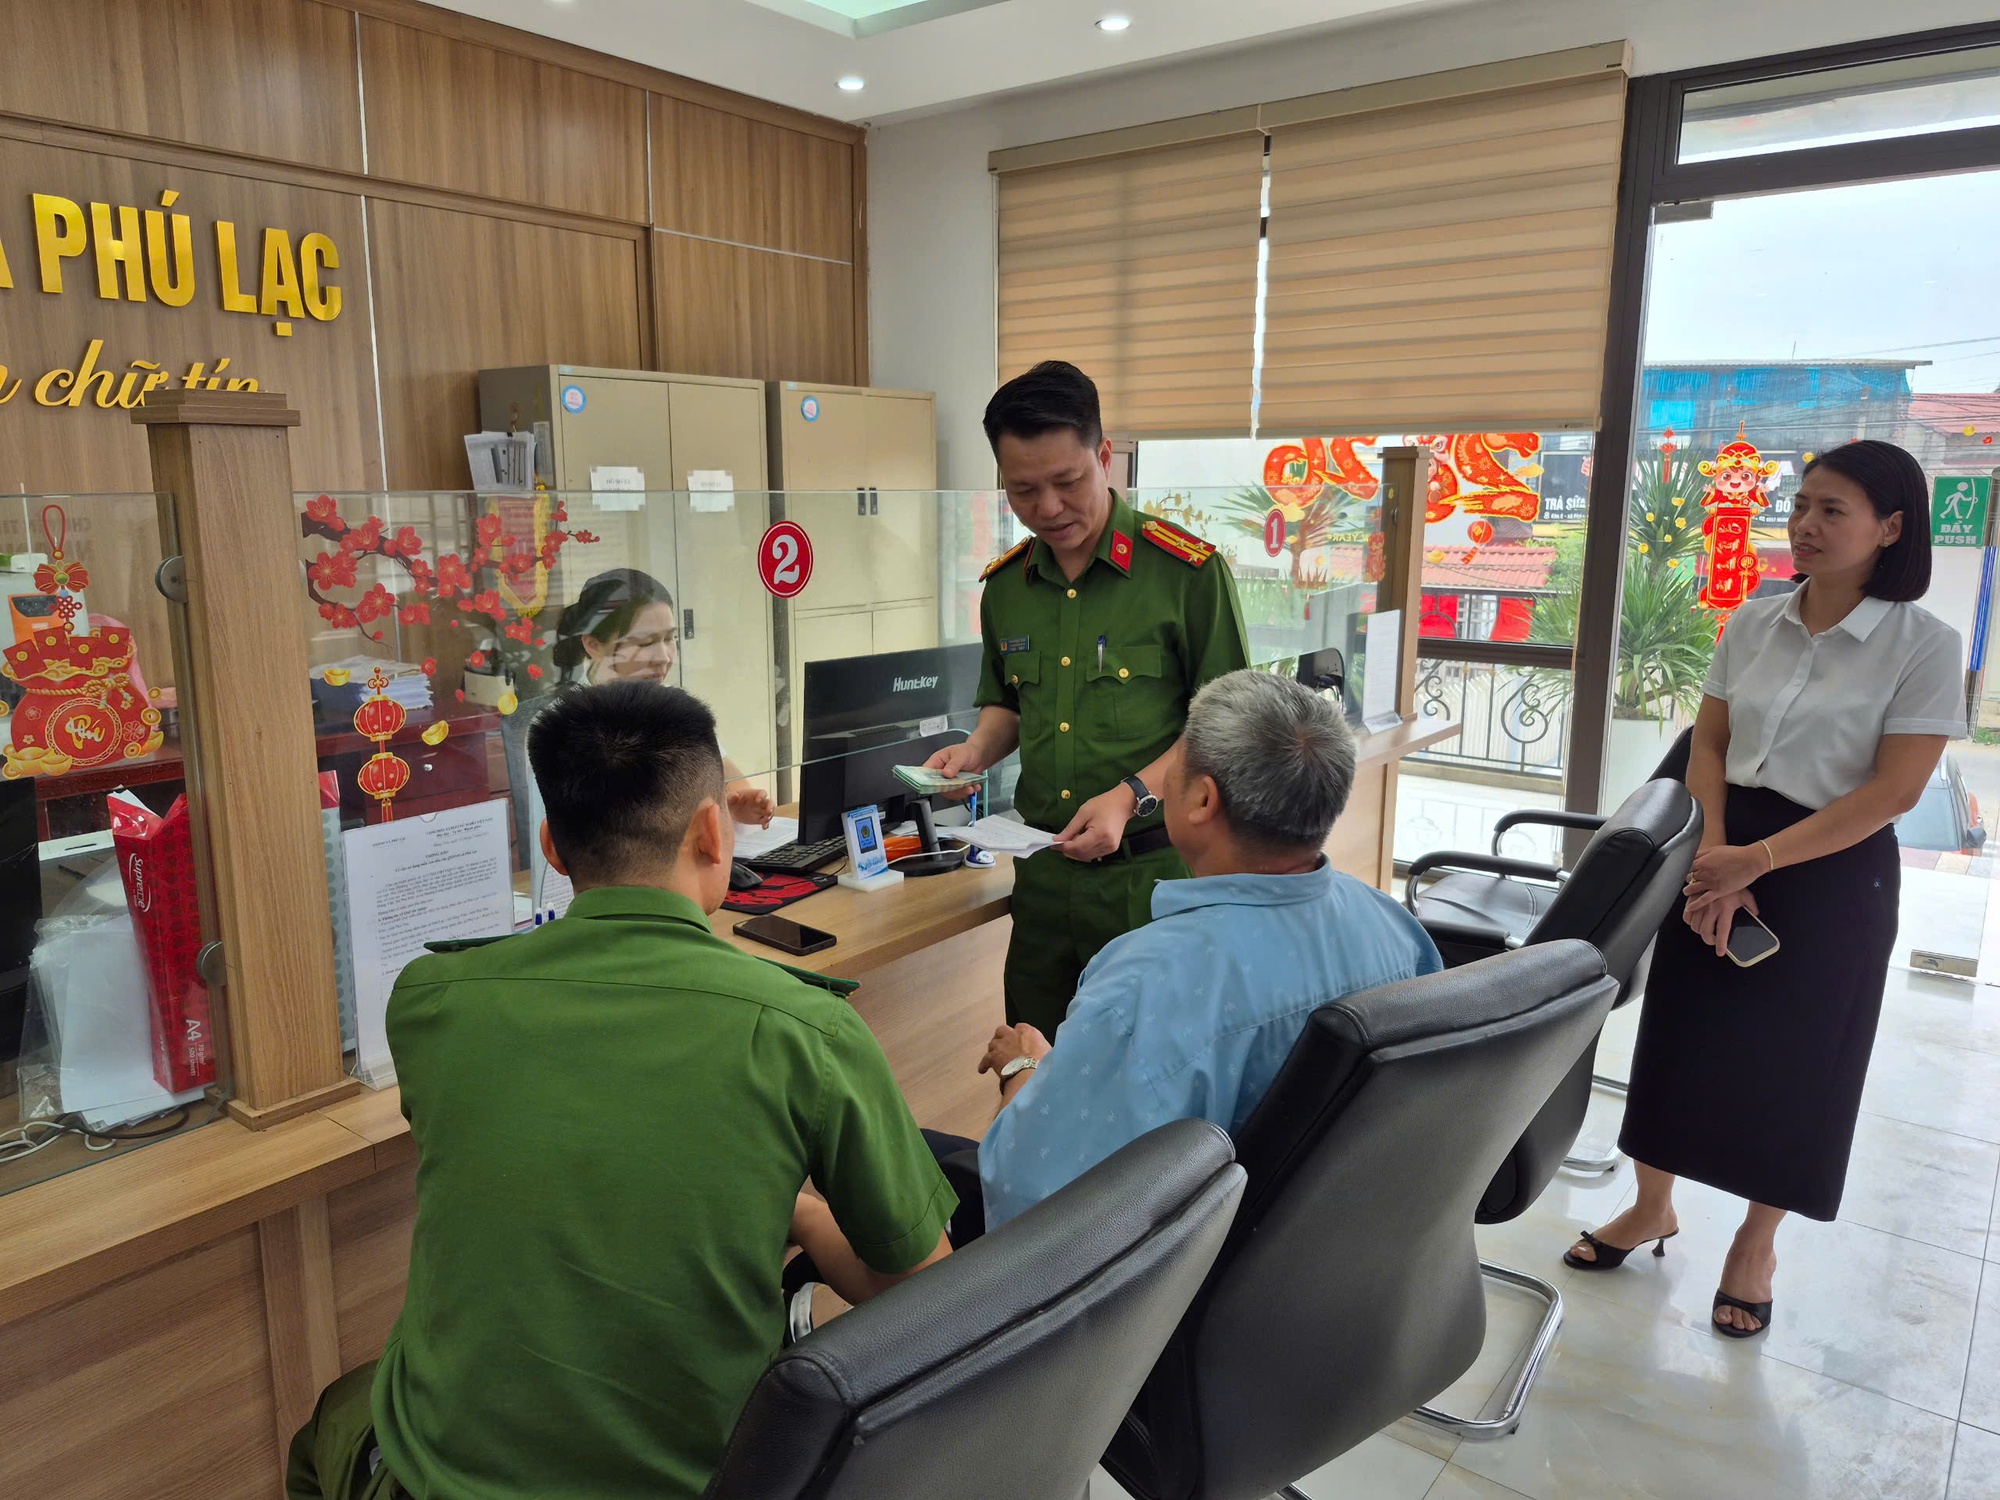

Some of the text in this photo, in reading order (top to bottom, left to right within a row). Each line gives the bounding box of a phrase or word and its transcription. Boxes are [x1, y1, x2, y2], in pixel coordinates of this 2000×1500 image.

[33, 189, 196, 307] PHÚ
[216, 220, 342, 336] LẠC
[34, 339, 170, 409] chữ
[1545, 494, 1563, 511] TRÀ
[1270, 517, 1279, 549] 1
[1934, 535, 1977, 544] PUSH
[1941, 520, 1973, 533] ĐẨY
[772, 534, 800, 585] 2
[893, 676, 939, 692] Huntkey
[133, 856, 146, 909] Supreme
[185, 1019, 202, 1041] A4
